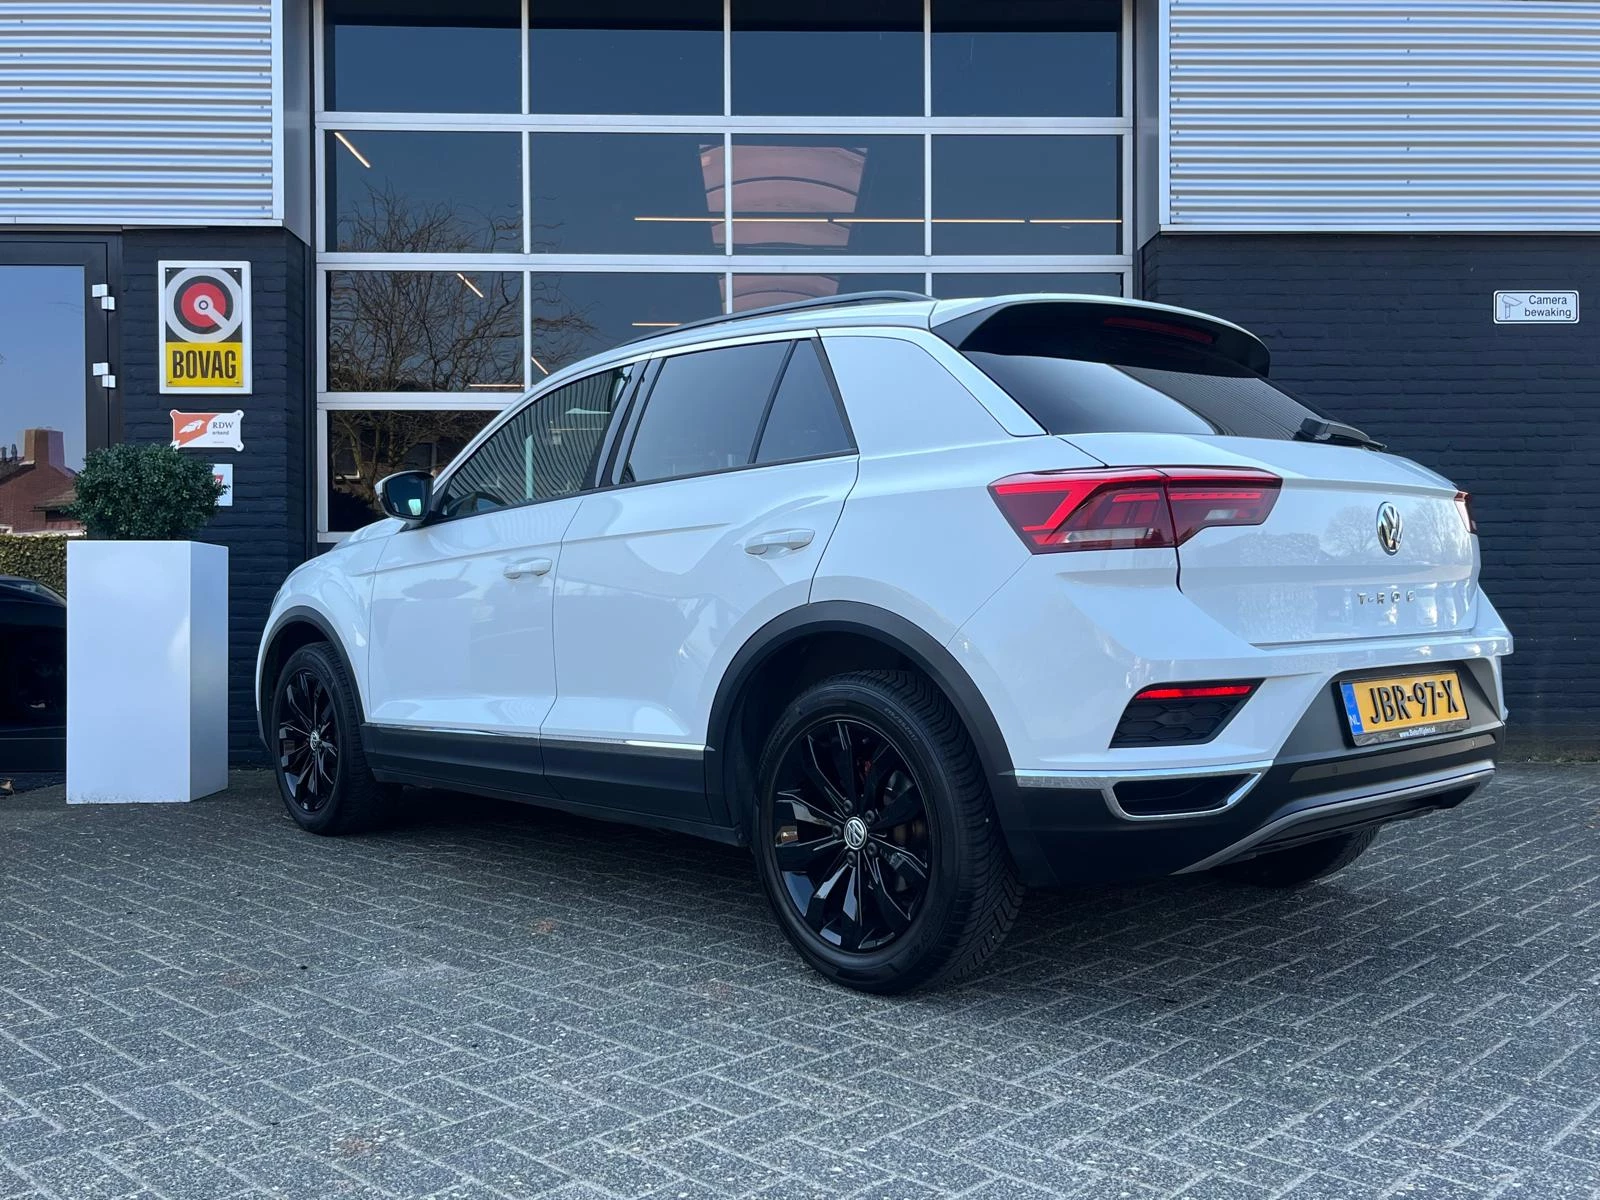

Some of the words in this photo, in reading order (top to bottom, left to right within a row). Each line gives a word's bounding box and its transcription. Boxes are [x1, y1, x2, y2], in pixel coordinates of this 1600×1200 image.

[1528, 294, 1568, 305] Camera
[1524, 307, 1572, 319] bewaking
[172, 350, 237, 379] BOVAG
[212, 421, 234, 429] RDW
[1370, 679, 1459, 725] JBR-97-X
[1349, 714, 1361, 726] NL
